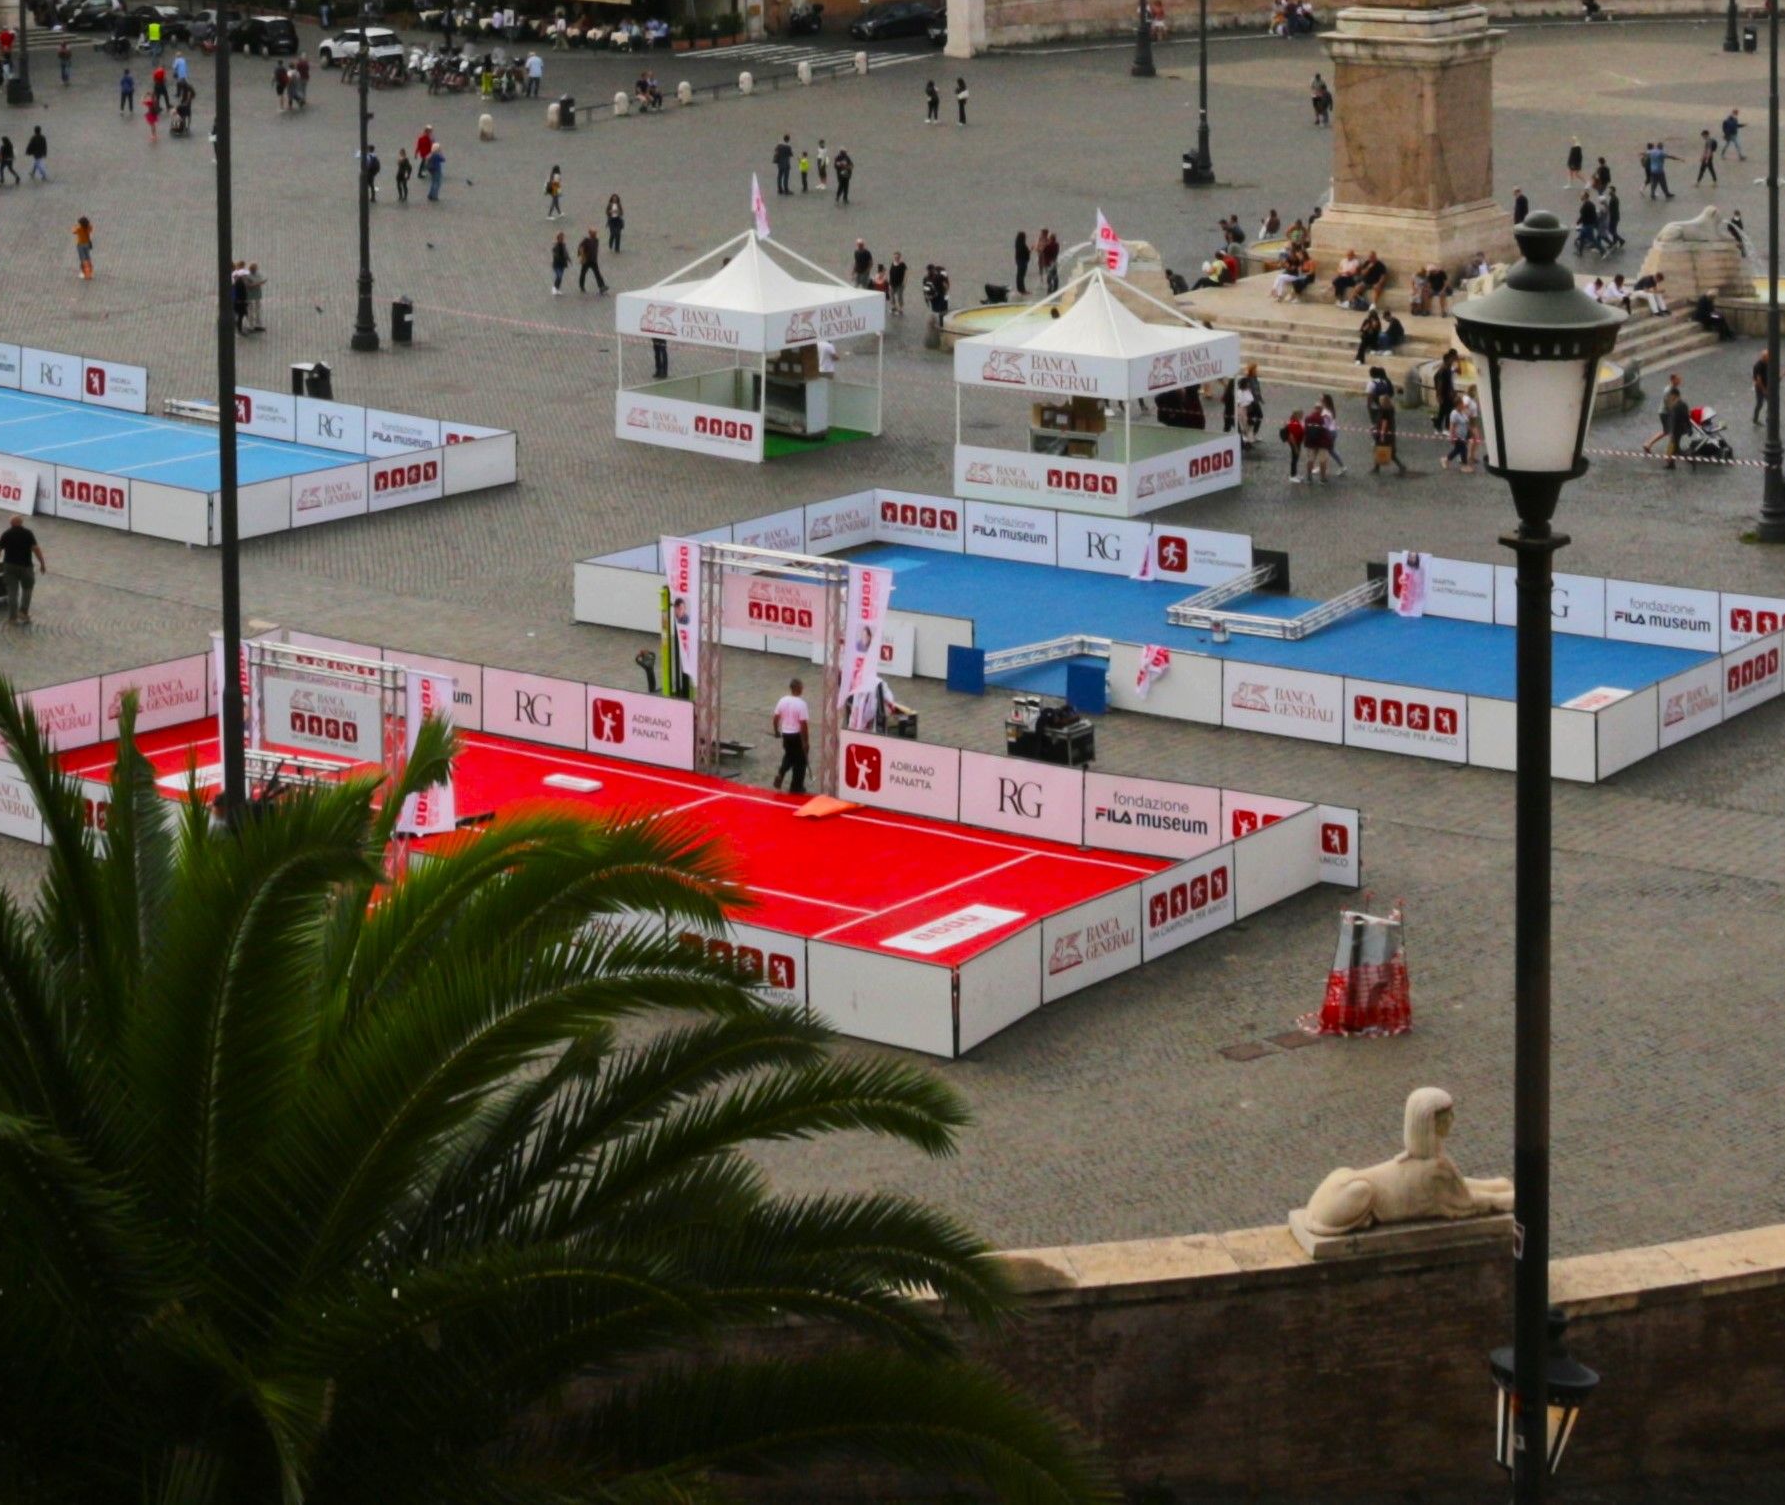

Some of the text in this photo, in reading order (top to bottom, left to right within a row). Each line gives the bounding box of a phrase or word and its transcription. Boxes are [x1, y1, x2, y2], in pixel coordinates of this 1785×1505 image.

[682, 307, 721, 327] BANCA
[819, 304, 853, 322] BANCA
[681, 325, 739, 344] GENERALI
[818, 318, 867, 338] GENERALI
[1031, 355, 1078, 375] BANCA
[1180, 348, 1211, 366] BANCA
[40, 362, 62, 387] RG
[1179, 360, 1223, 383] GENERALI
[1030, 372, 1099, 392] GENERALI
[318, 413, 343, 439] RG
[652, 411, 677, 423] BANCA
[381, 422, 423, 436] fondazione
[651, 421, 689, 436] GENERALI
[372, 431, 433, 449] FILA museum
[996, 464, 1027, 477] BANCA
[324, 481, 350, 494] BANCA
[995, 476, 1040, 490] GENERALI
[322, 491, 362, 507] GENERALI
[984, 513, 1036, 530] fondazione
[972, 524, 1048, 545] FILA museum
[1086, 531, 1120, 561] RG
[1629, 597, 1696, 616] fondazione
[1614, 610, 1712, 633] FILA museum
[147, 679, 185, 697] BANCA
[1275, 687, 1315, 705] BANCA
[146, 688, 200, 712] GENERALI
[515, 689, 553, 727] RG
[39, 701, 78, 721] BANCA
[1274, 703, 1334, 722] GENERALI
[632, 713, 672, 729] ADRIANO
[632, 727, 670, 742] PANATTA
[1367, 725, 1411, 740] CAMPIONE
[1412, 732, 1427, 742] PER
[1428, 734, 1457, 746] AMICO
[889, 760, 935, 777] ADRIANO
[889, 774, 932, 791] PANATTA
[998, 777, 1044, 819] RG
[1113, 791, 1190, 814] fondazione
[1095, 806, 1209, 835] FILA museum
[1086, 917, 1121, 943] BANCA
[1085, 927, 1136, 962] GENERALI
